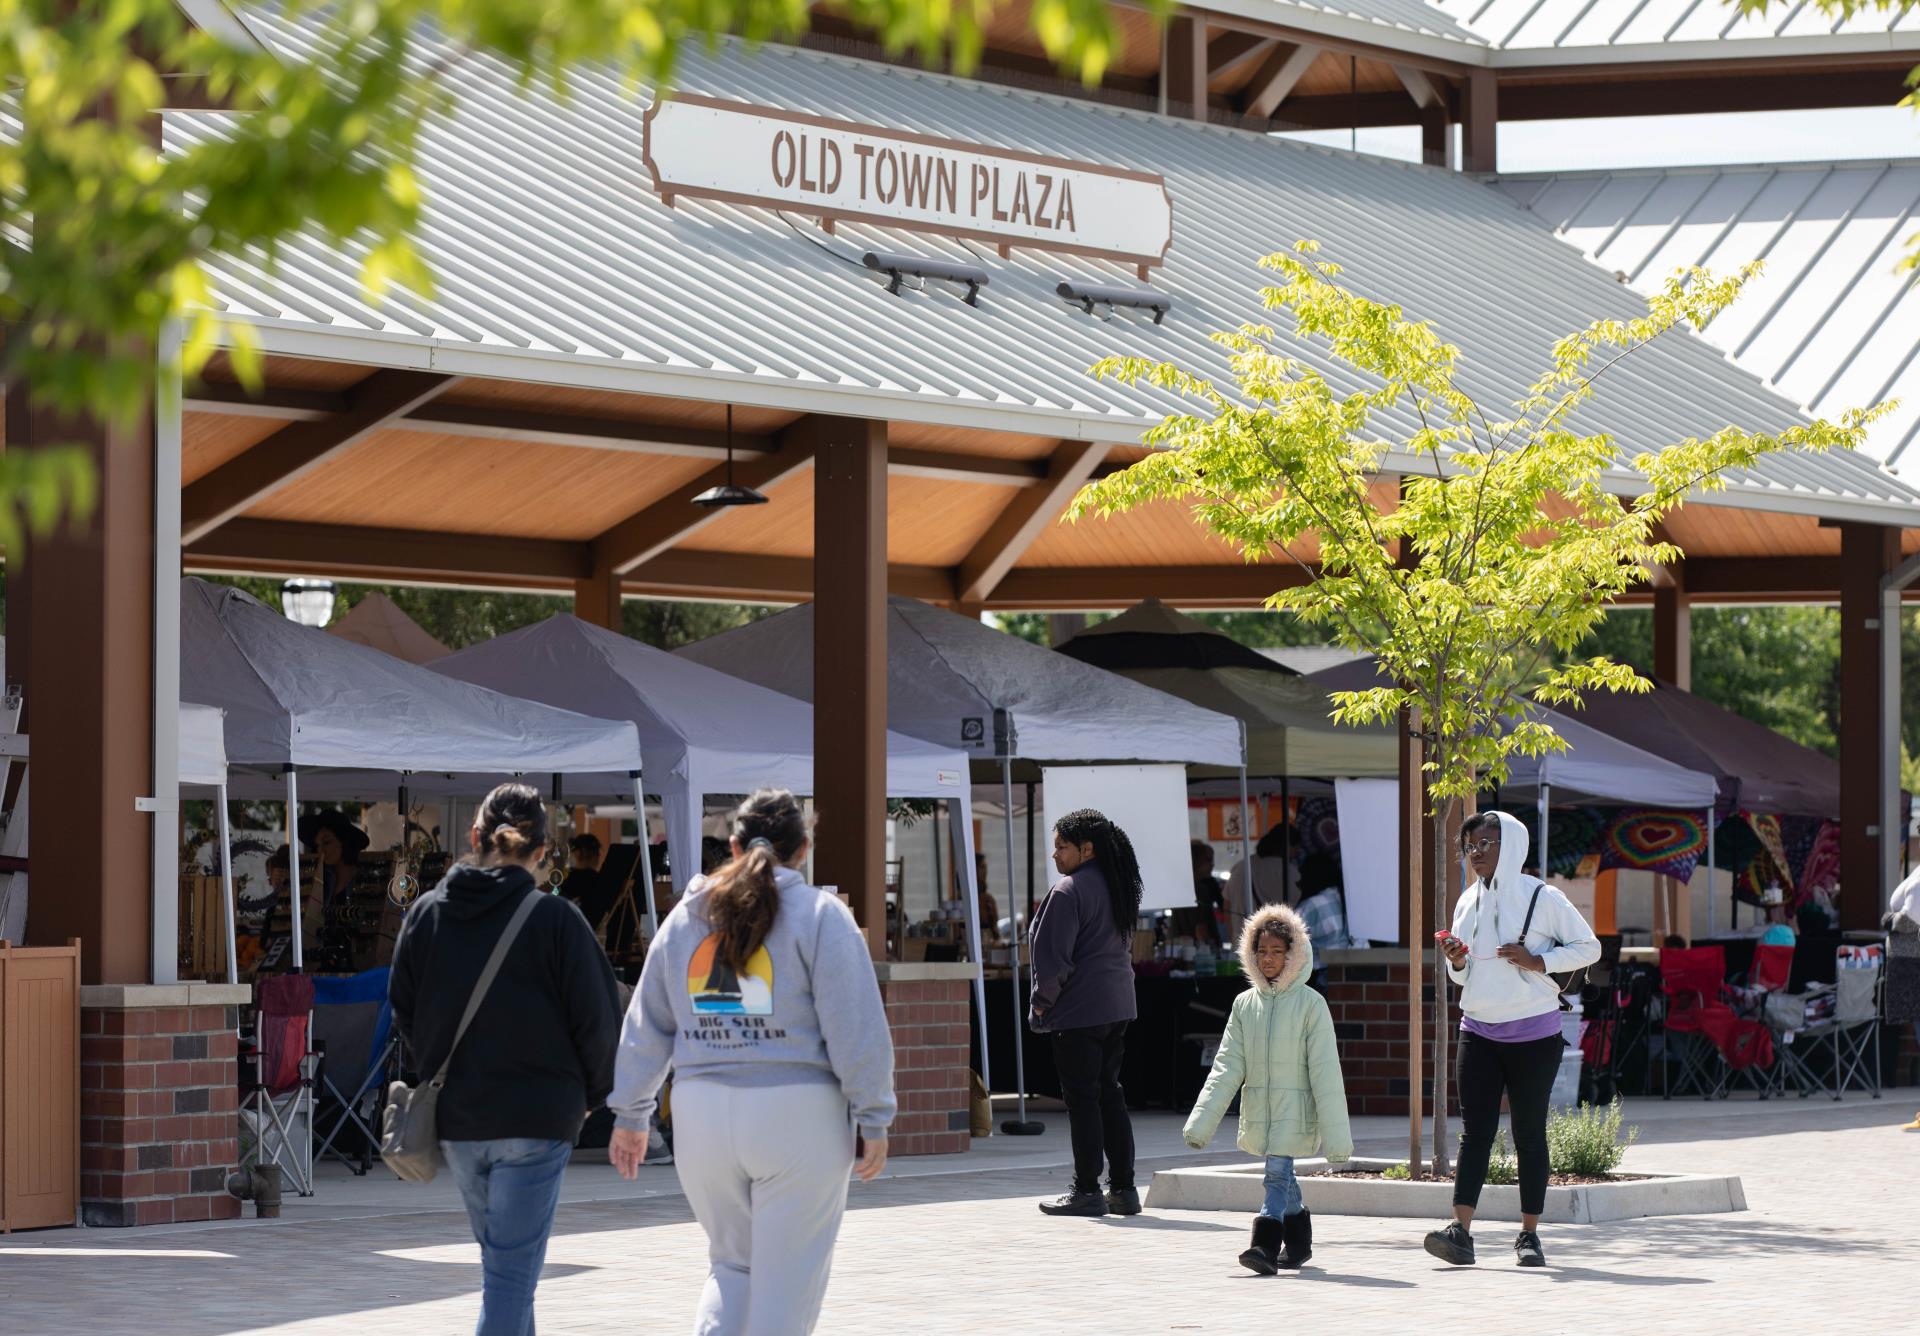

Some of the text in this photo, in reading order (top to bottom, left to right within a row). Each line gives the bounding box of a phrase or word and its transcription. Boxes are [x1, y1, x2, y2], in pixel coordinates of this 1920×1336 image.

[772, 130, 1076, 233] OLD TOWN PLAZA
[698, 1016, 765, 1028] BIG SUR
[684, 1028, 787, 1041] YACHT CLUB
